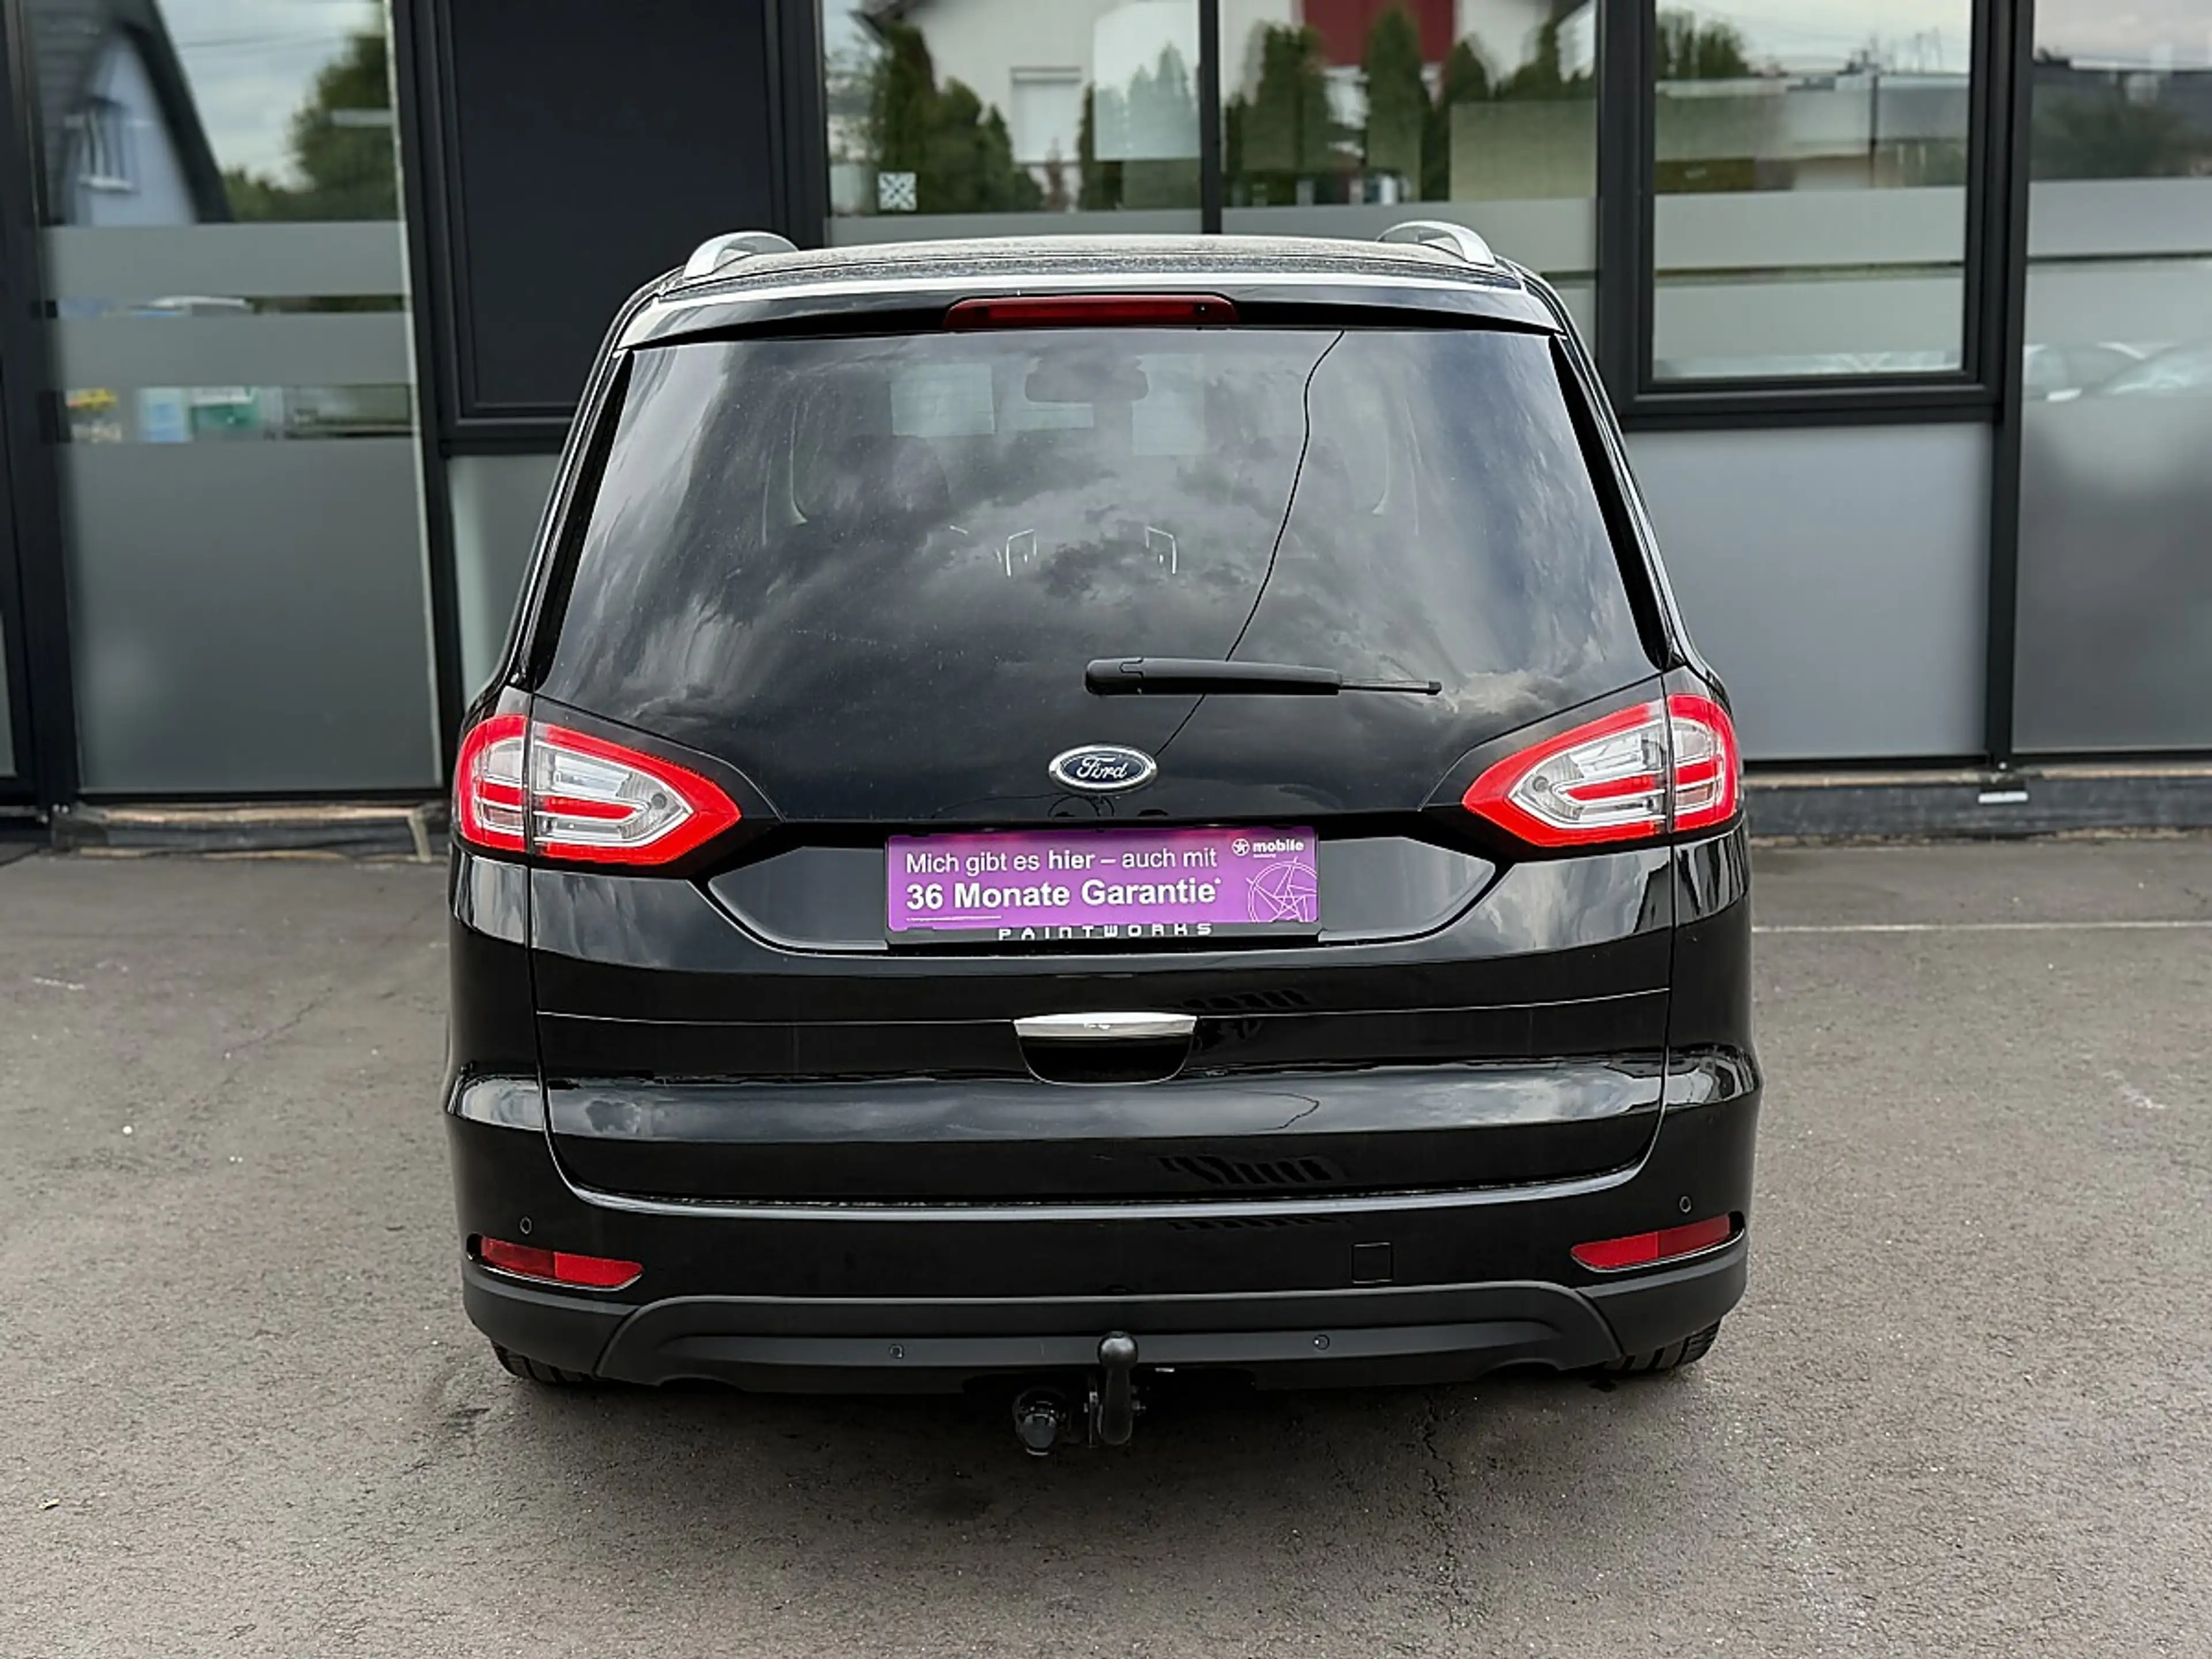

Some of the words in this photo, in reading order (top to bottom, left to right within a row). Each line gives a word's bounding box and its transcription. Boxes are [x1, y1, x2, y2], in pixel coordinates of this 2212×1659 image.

[1077, 756, 1128, 779] Ford
[906, 853, 959, 873] Mich
[965, 851, 1007, 876] gibt
[1013, 854, 1040, 871] es
[1048, 850, 1096, 869] hier
[1122, 848, 1176, 868] auch
[1183, 847, 1217, 868] mit
[906, 883, 944, 910] 36
[954, 881, 1070, 908] Monate
